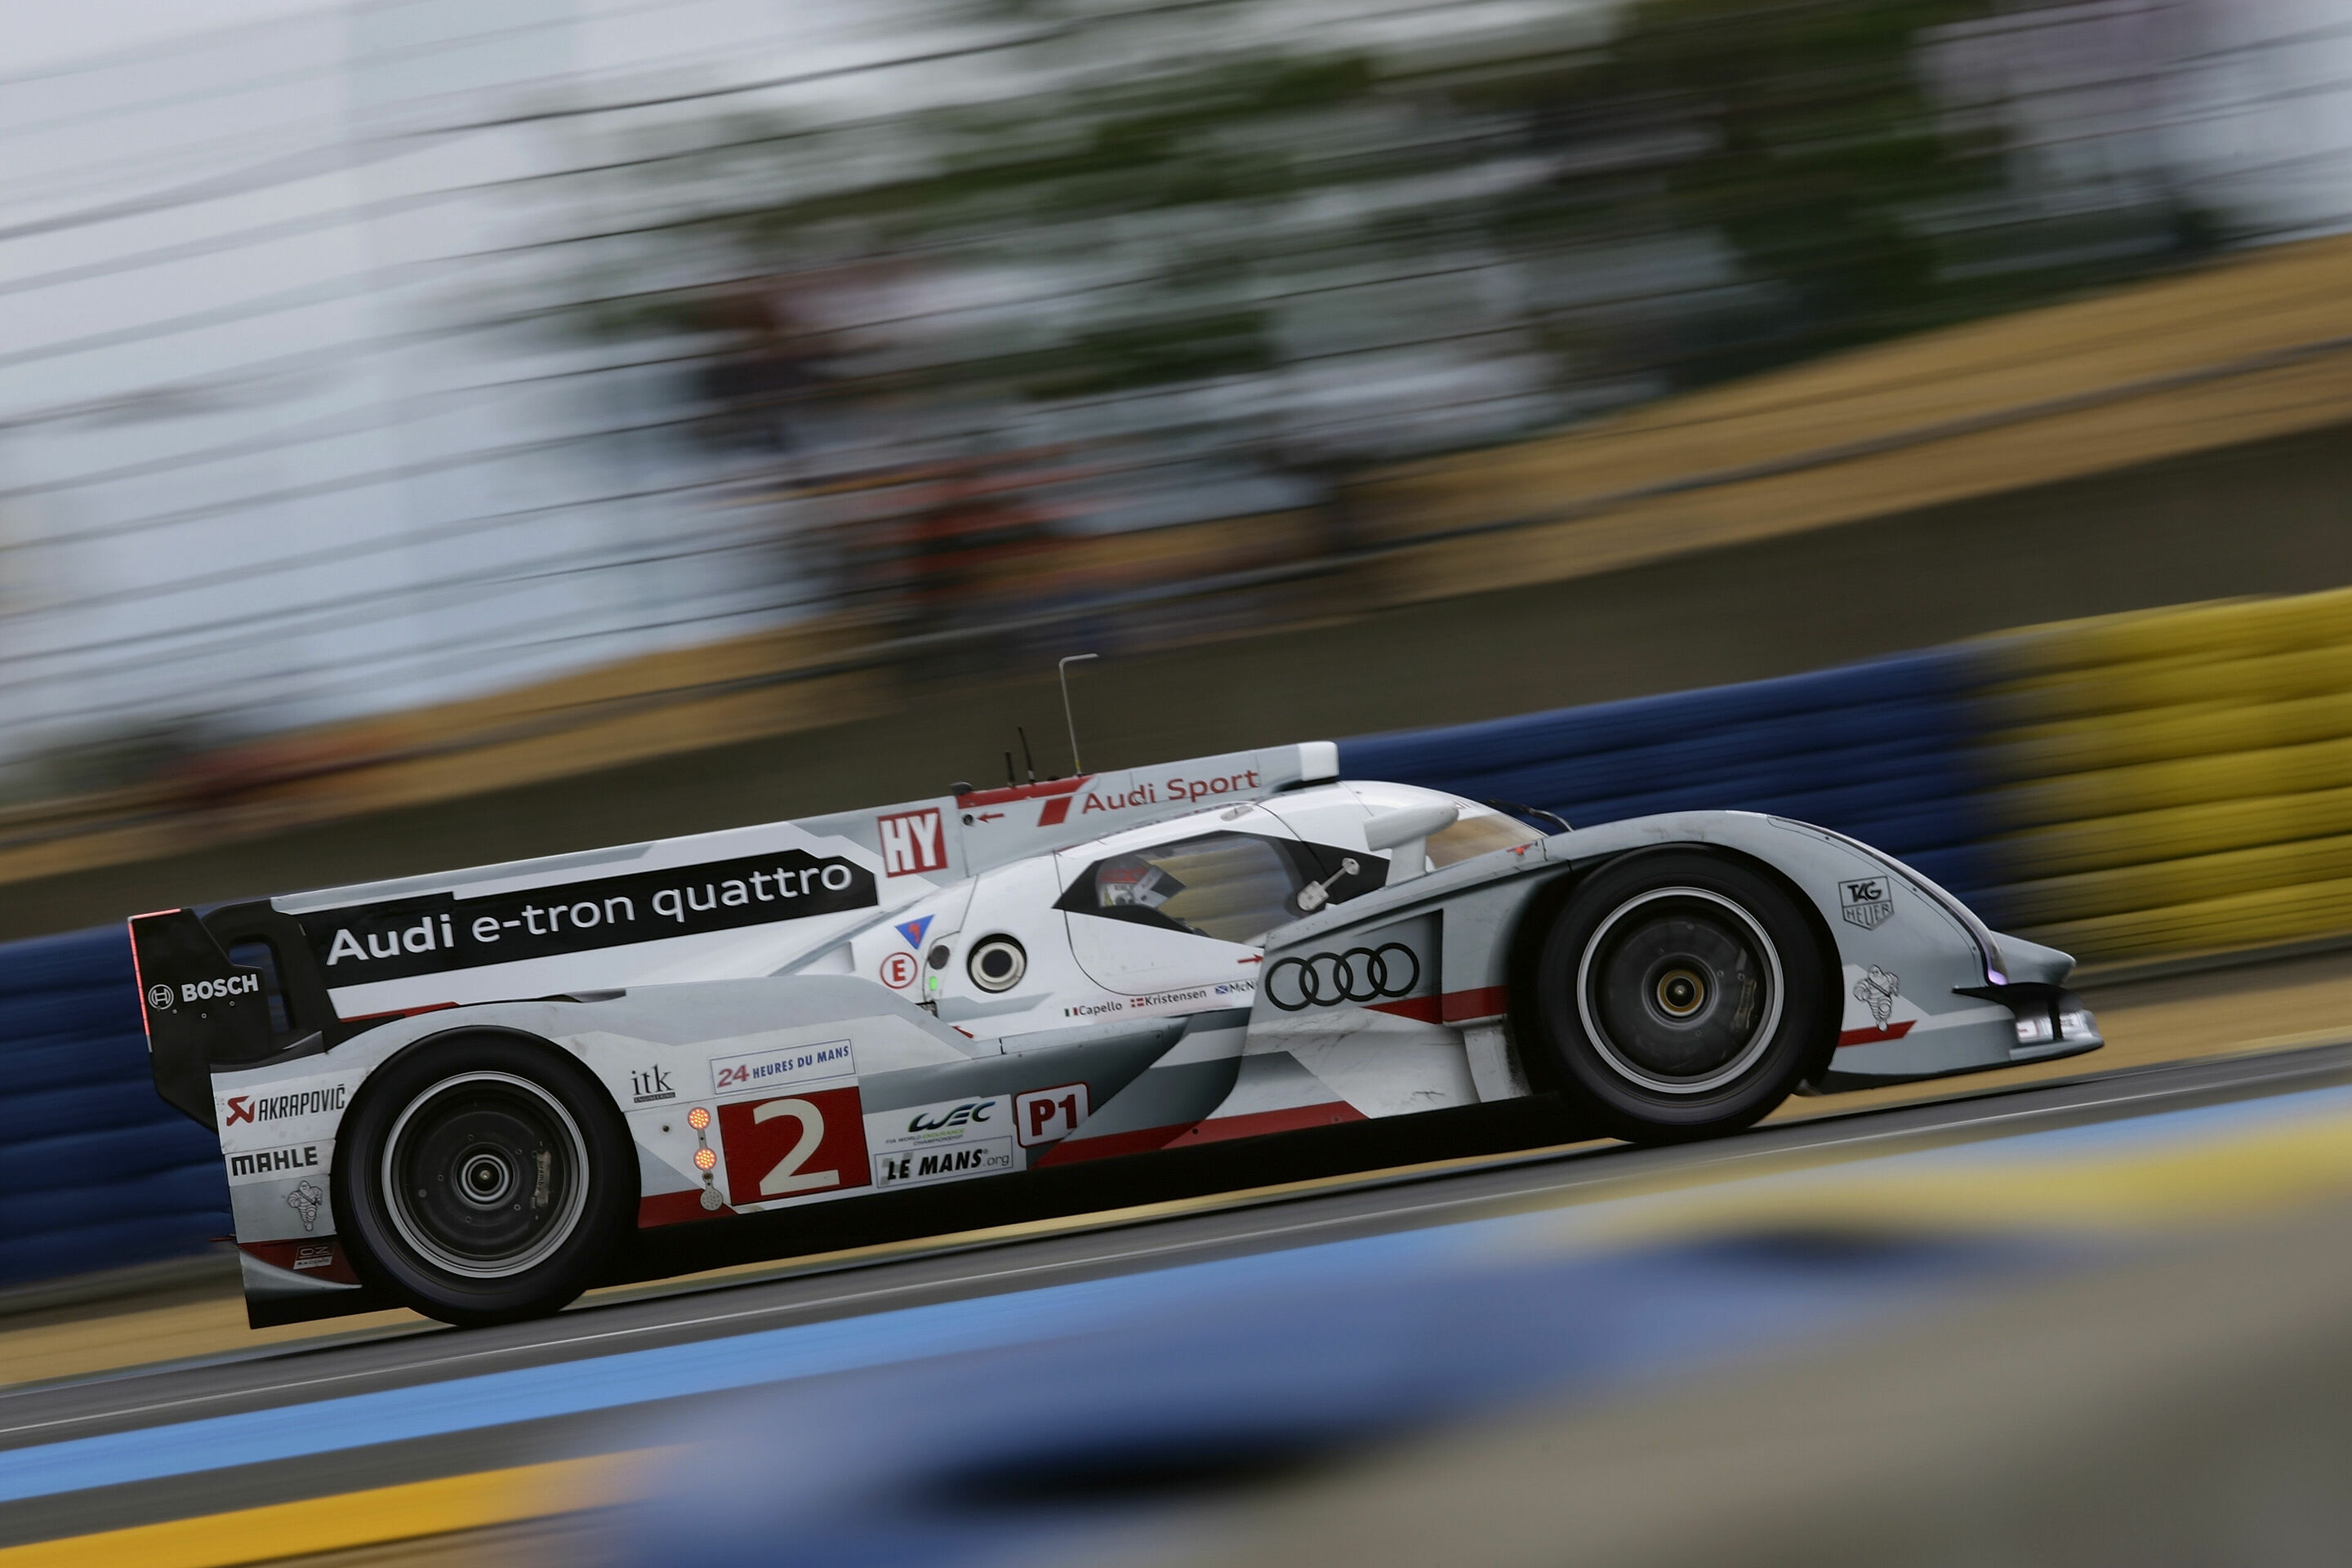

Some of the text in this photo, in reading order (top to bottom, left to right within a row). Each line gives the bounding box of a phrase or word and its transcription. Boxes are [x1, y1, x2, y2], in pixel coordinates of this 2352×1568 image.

[1082, 769, 1260, 814] Audi Sport
[880, 812, 939, 874] HY
[1847, 880, 1882, 902] TAG
[327, 863, 853, 966] Audi e-tron quattro
[1846, 903, 1892, 926] HEUER
[892, 959, 906, 982] E
[180, 973, 259, 1003] BOSCH
[1078, 1000, 1123, 1016] Capello
[1144, 989, 1207, 1007] Kristensen
[630, 1062, 676, 1095] itk
[717, 1045, 849, 1089] 24 HEURES DU MANS
[634, 1092, 675, 1102] ENGINEERING
[908, 1101, 996, 1133] WEC
[1029, 1094, 1077, 1137] P1
[231, 1146, 318, 1177] MAHLE
[752, 1098, 841, 1196] 2
[887, 1158, 911, 1181] LE
